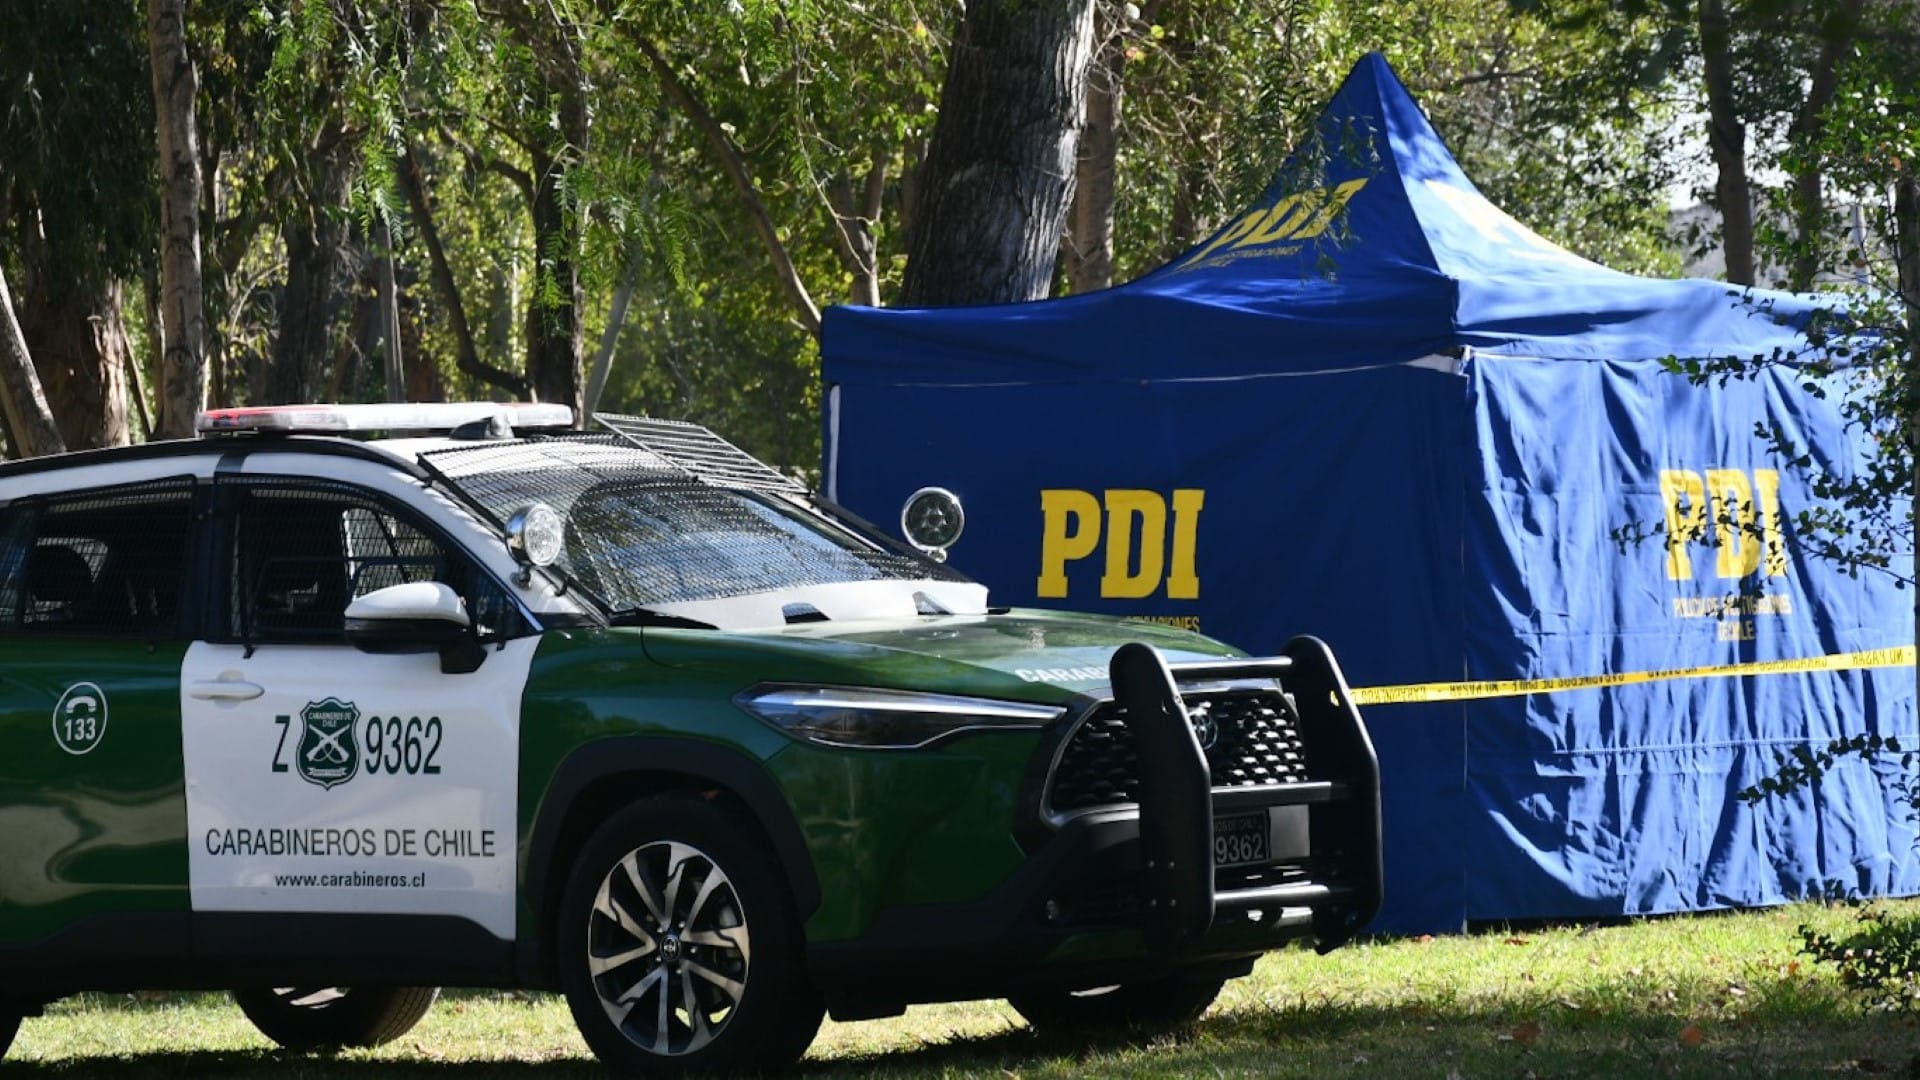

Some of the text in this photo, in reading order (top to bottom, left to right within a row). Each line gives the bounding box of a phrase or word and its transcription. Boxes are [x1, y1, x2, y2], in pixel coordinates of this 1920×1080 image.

[1174, 178, 1369, 272] PDI
[1037, 488, 1205, 599] PDI
[1659, 468, 1788, 581] PDI
[65, 718, 96, 742] 133
[272, 715, 442, 775] Z 9362
[206, 828, 495, 857] CARABINEROS DE CHILE
[1215, 833, 1264, 864] 9362
[275, 871, 426, 889] www.carabineros.cl
